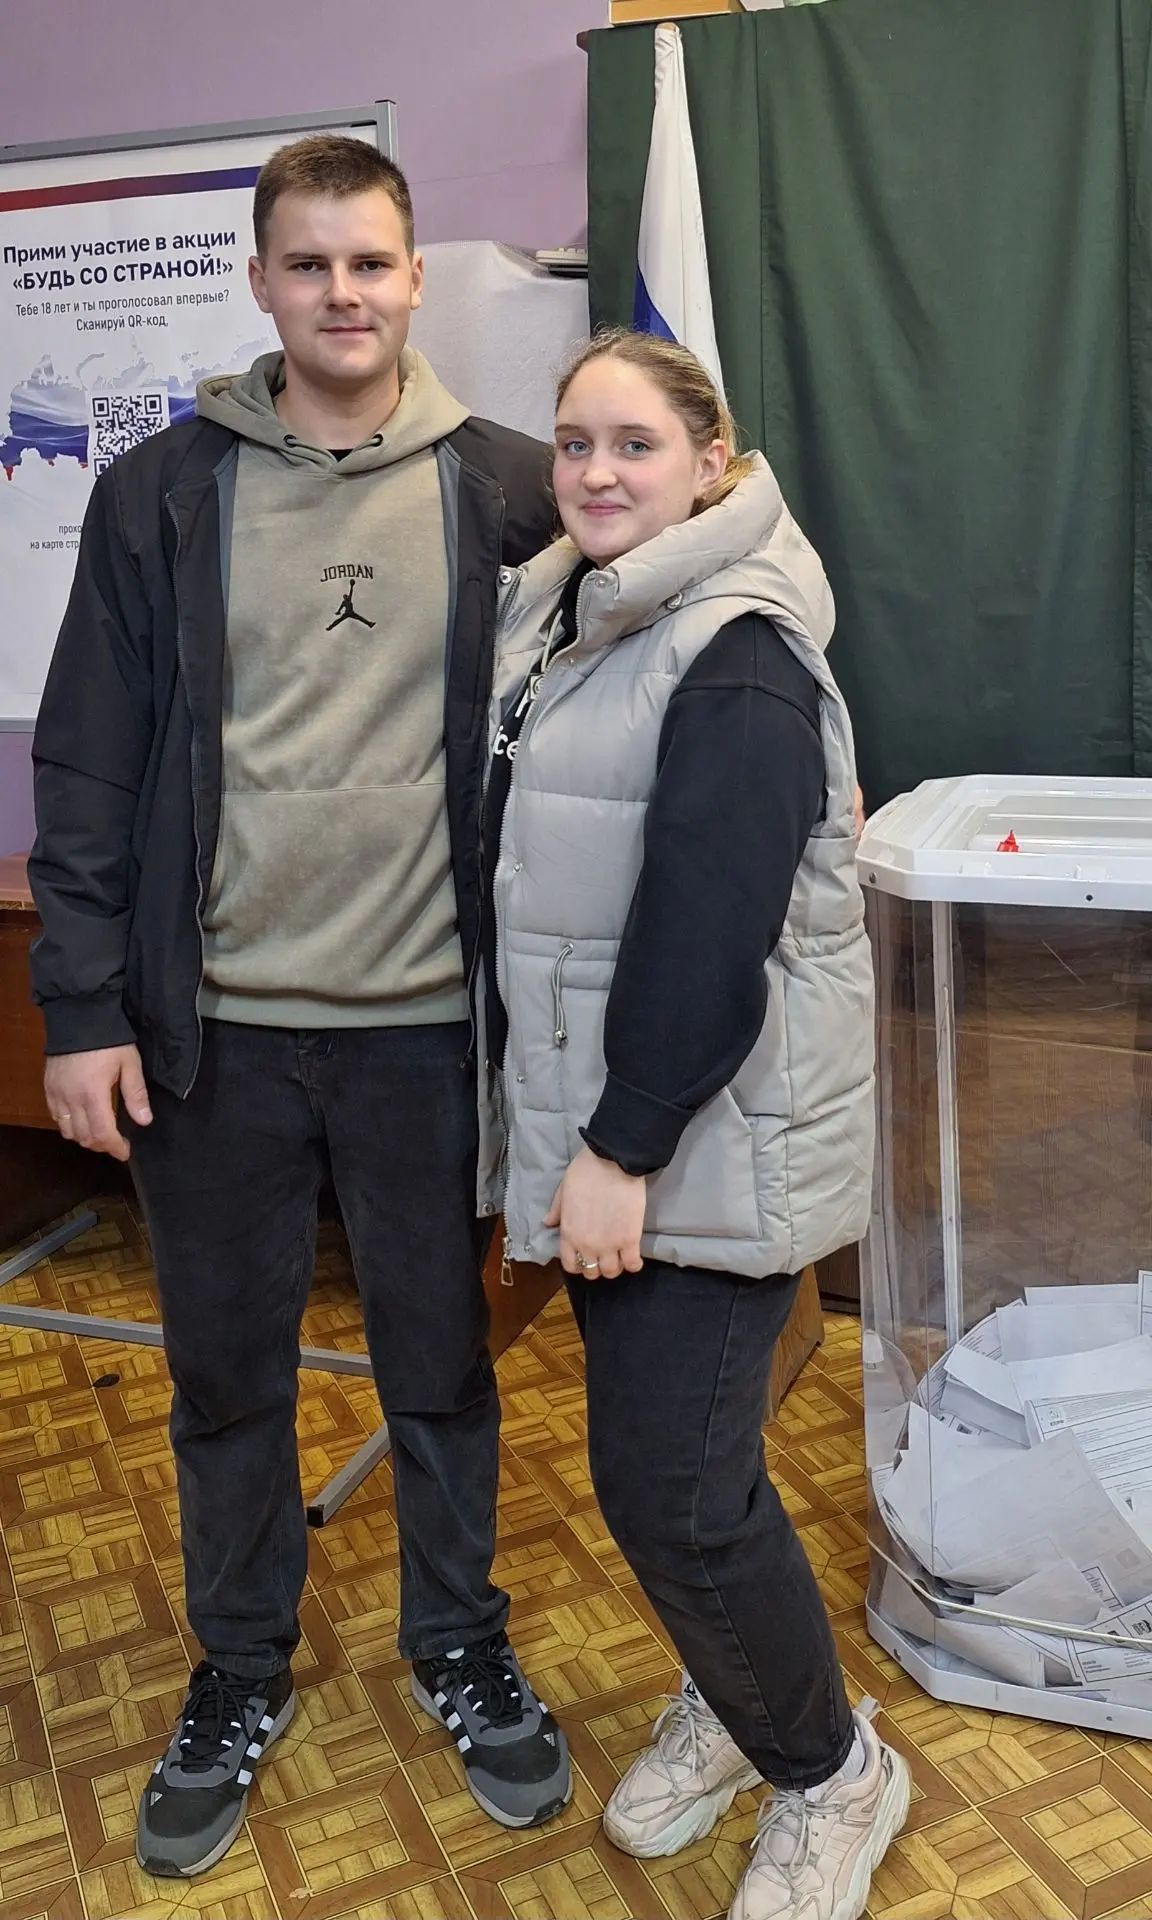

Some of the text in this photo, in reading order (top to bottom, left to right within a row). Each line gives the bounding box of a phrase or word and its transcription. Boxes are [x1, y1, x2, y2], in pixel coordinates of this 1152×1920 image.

[4, 231, 236, 266] Прими участие в акции
[13, 254, 233, 290] «БУДЬ СО СТРАНОЙ!»
[16, 289, 230, 316] Тебе 18 лет и ты проголосовал впервые?
[76, 315, 125, 331] Сканируй
[30, 541, 40, 549] на
[41, 540, 64, 550] карте
[320, 564, 374, 582] JORDAN
